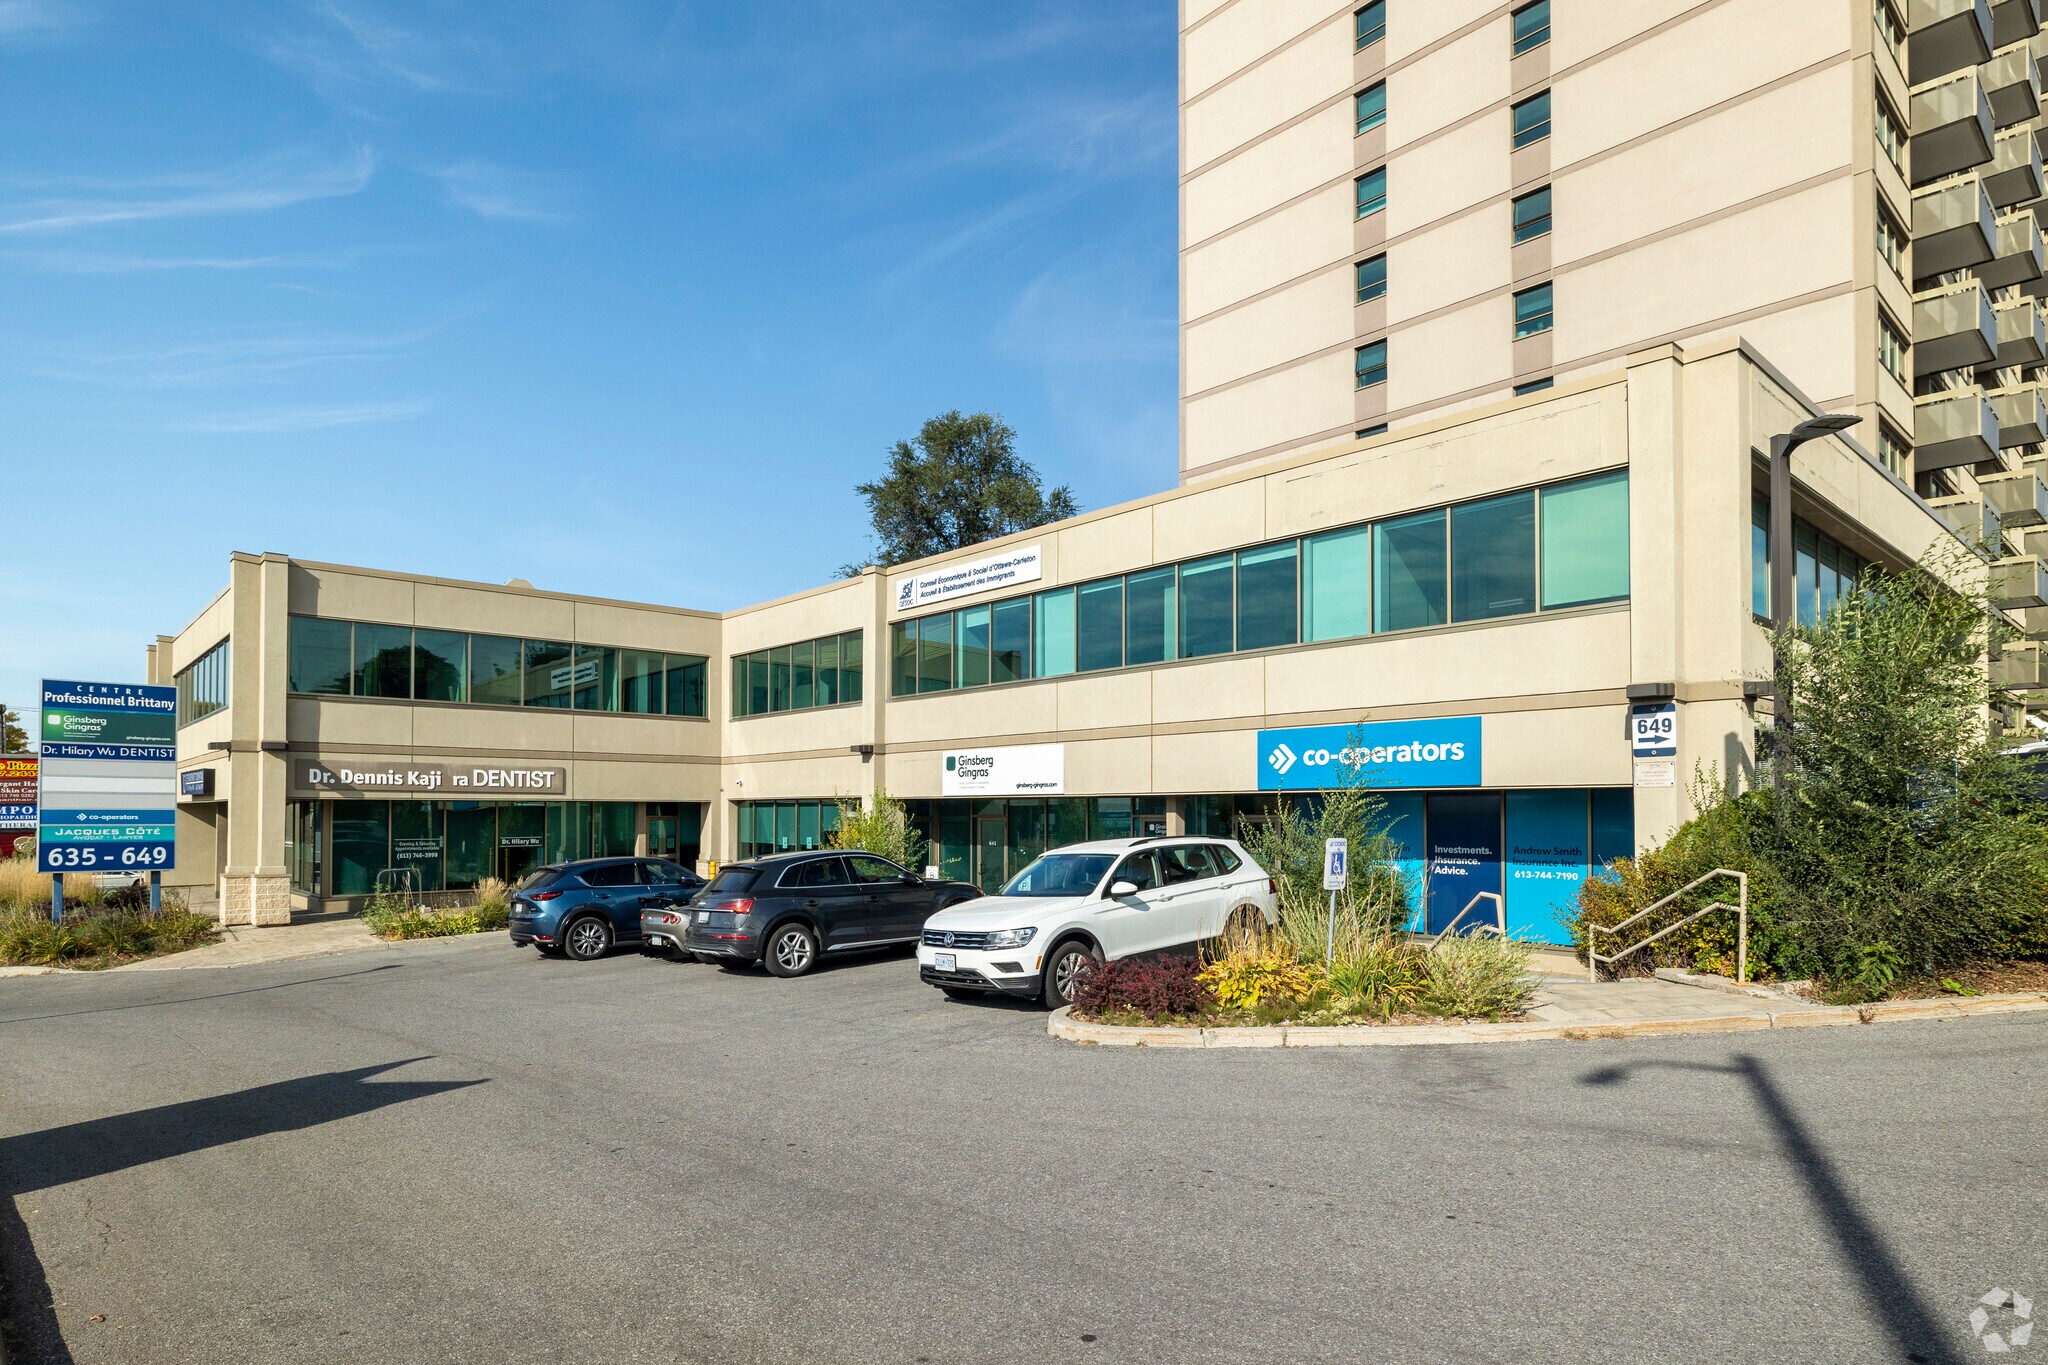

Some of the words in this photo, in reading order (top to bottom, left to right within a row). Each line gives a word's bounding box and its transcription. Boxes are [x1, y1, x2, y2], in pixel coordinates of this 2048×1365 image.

[920, 578, 937, 588] Conseil
[938, 572, 967, 584] Économique
[973, 565, 988, 575] Social
[920, 588, 937, 598] Accueil
[976, 576, 986, 584] des
[986, 570, 1015, 582] Immigrants
[77, 685, 143, 695] CENTRE
[44, 691, 125, 706] Professionnel
[127, 696, 175, 711] Brittany
[63, 715, 107, 726] Ginsberg
[1637, 718, 1672, 734] 649
[63, 723, 101, 732] Gingras
[42, 745, 58, 754] Dr.
[62, 746, 94, 757] Hilary
[97, 747, 115, 756] Wu
[120, 748, 175, 758] DENTIST
[1303, 740, 1465, 771] co-operators
[958, 755, 994, 768] Ginsberg
[309, 768, 335, 784] Dr.
[340, 769, 404, 786] Dennis
[407, 770, 442, 790] Kaji
[473, 768, 555, 788] DENTIST
[958, 767, 989, 780] Gingras
[0, 806, 37, 815] MPO
[55, 828, 119, 836] JACQUES
[126, 826, 161, 835] CÔTÉ
[512, 838, 529, 846] Hilary
[1435, 845, 1492, 855] Investments.
[1513, 846, 1552, 855] Andrew
[1553, 846, 1582, 856] Smith
[48, 847, 96, 867] 635
[121, 846, 167, 865] 649
[1434, 855, 1481, 865] Insurance.
[1512, 857, 1559, 867] Insurance
[1561, 859, 1579, 868] Inc.
[1434, 865, 1469, 875] Advice.
[1514, 870, 1579, 880] 613-744-7190
